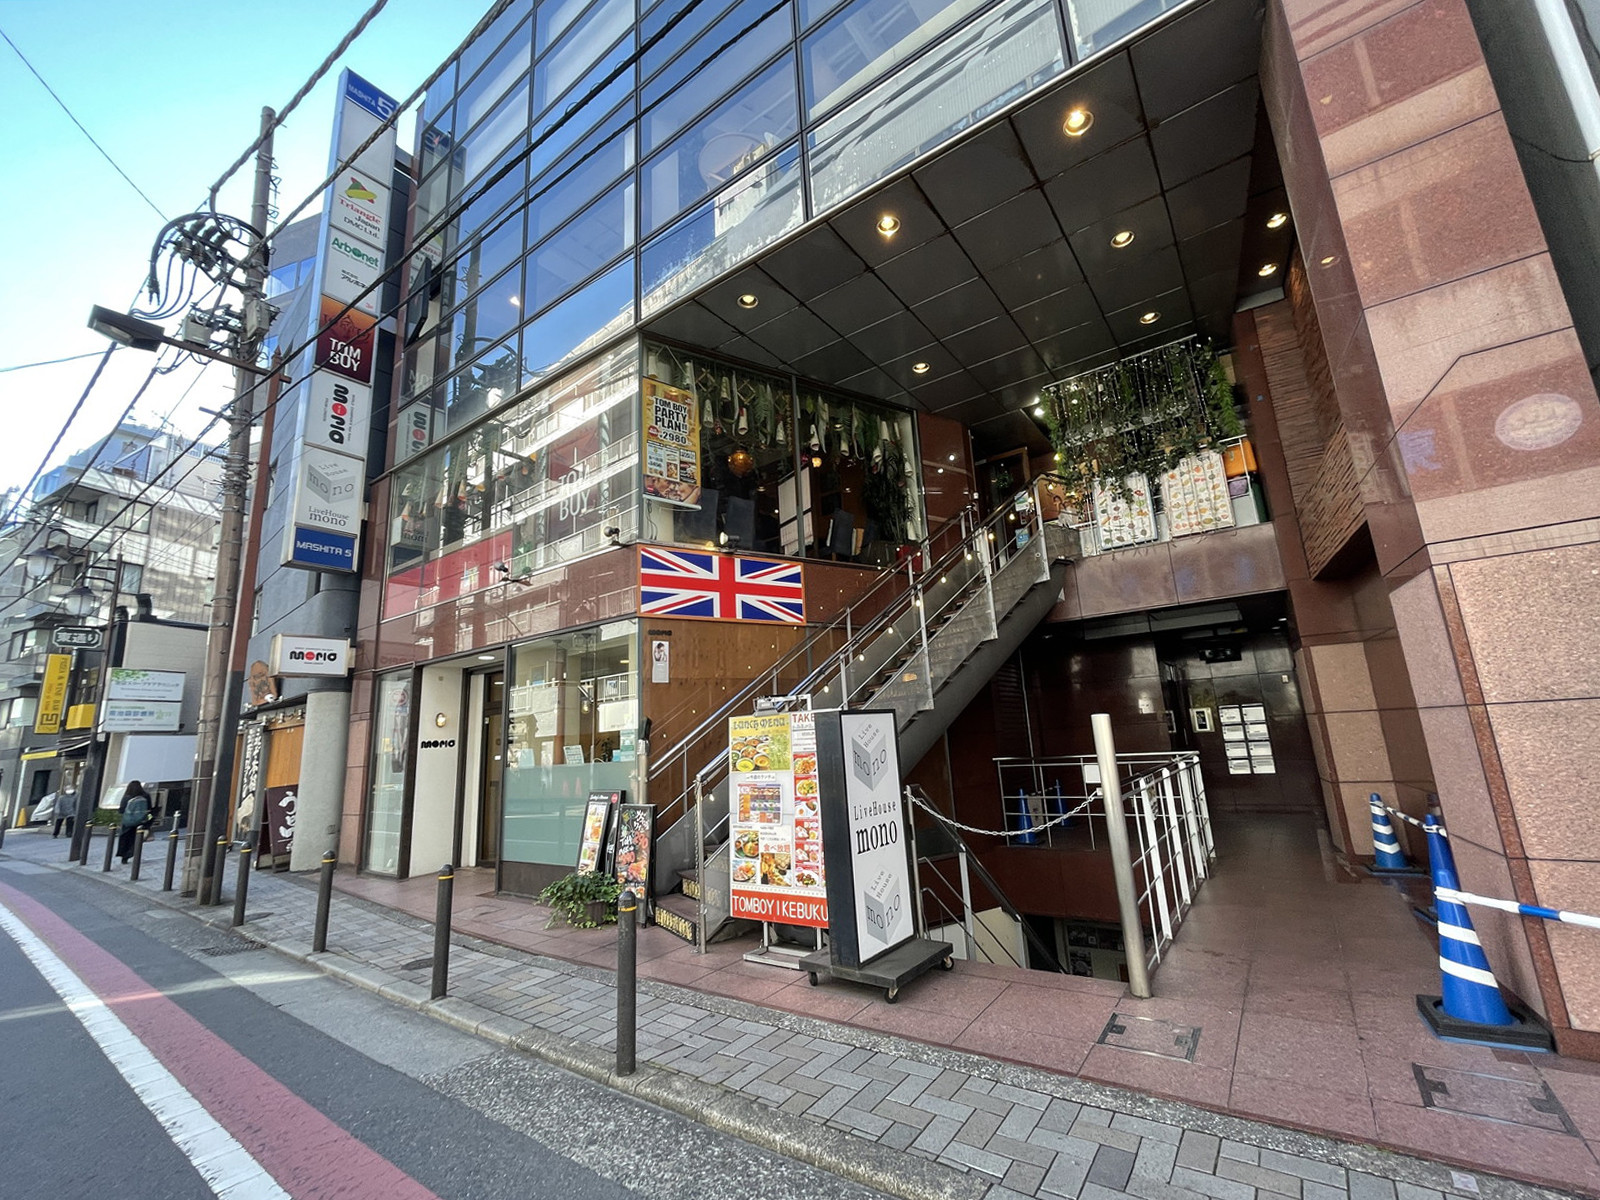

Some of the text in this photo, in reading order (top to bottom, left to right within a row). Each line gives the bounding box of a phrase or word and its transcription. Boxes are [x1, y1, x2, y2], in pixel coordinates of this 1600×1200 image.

[377, 97, 393, 118] 5
[355, 215, 380, 231] Japan
[332, 237, 379, 267] Arbonet
[330, 337, 361, 360] TOM
[330, 351, 360, 372] BOY
[654, 405, 687, 423] PARTY
[655, 397, 687, 414] TOM BOY
[308, 506, 349, 520] LiveHouse
[309, 512, 346, 527] mono
[296, 540, 343, 556] MASHITA
[792, 713, 815, 723] TAKE
[858, 723, 873, 740] Live
[863, 727, 880, 748] House
[854, 801, 896, 821] LiveHouse
[856, 820, 898, 855] mono
[871, 870, 885, 890] Live
[876, 873, 893, 899] House
[732, 896, 775, 915] TOMBOY
